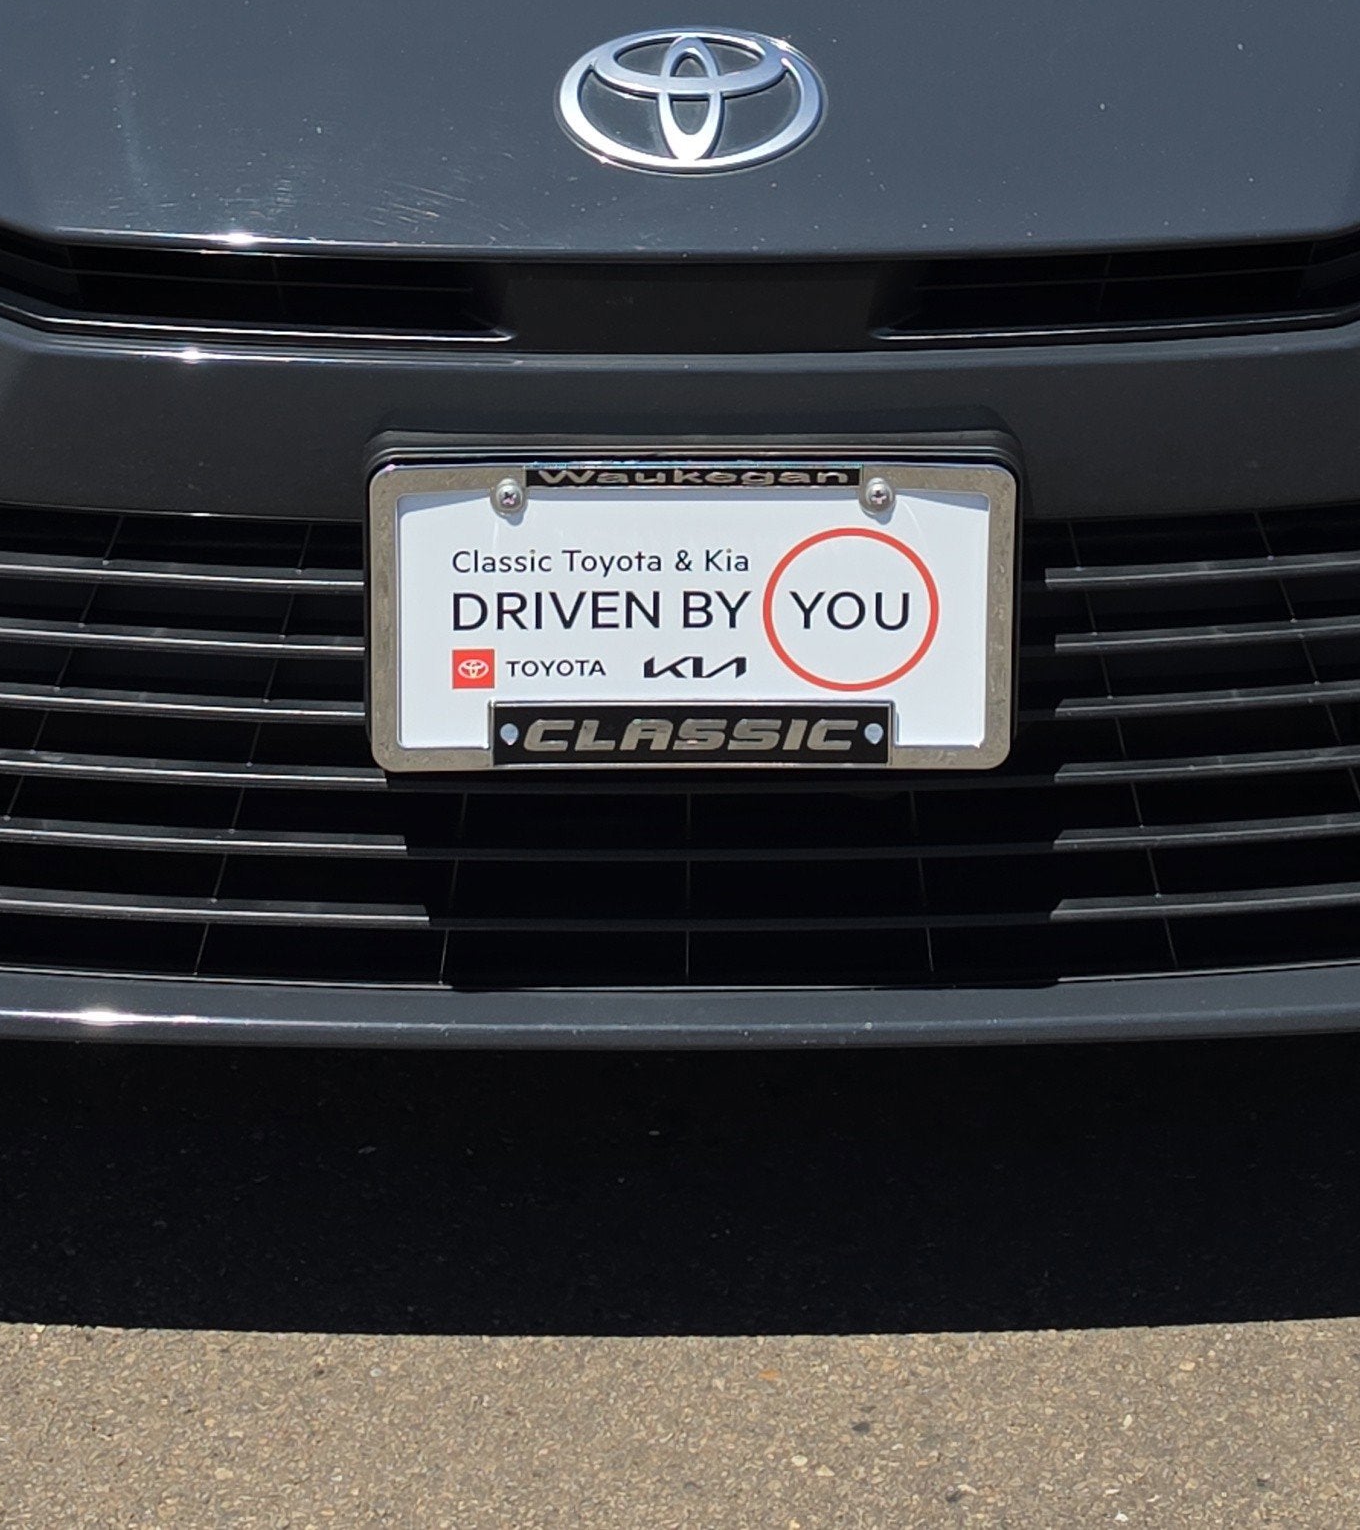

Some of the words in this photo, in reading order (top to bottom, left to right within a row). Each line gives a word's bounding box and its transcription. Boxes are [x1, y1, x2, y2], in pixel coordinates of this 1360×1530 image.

[538, 468, 849, 486] Waukegan
[451, 549, 552, 573] Classic
[561, 549, 662, 577] Toyota
[675, 549, 693, 572] &
[704, 549, 750, 572] Kia
[452, 590, 660, 631] DRIVEN
[681, 590, 751, 629] BY
[789, 591, 910, 631] YOU
[506, 659, 606, 677] TOYOTA
[523, 718, 859, 752] CLASSIC
